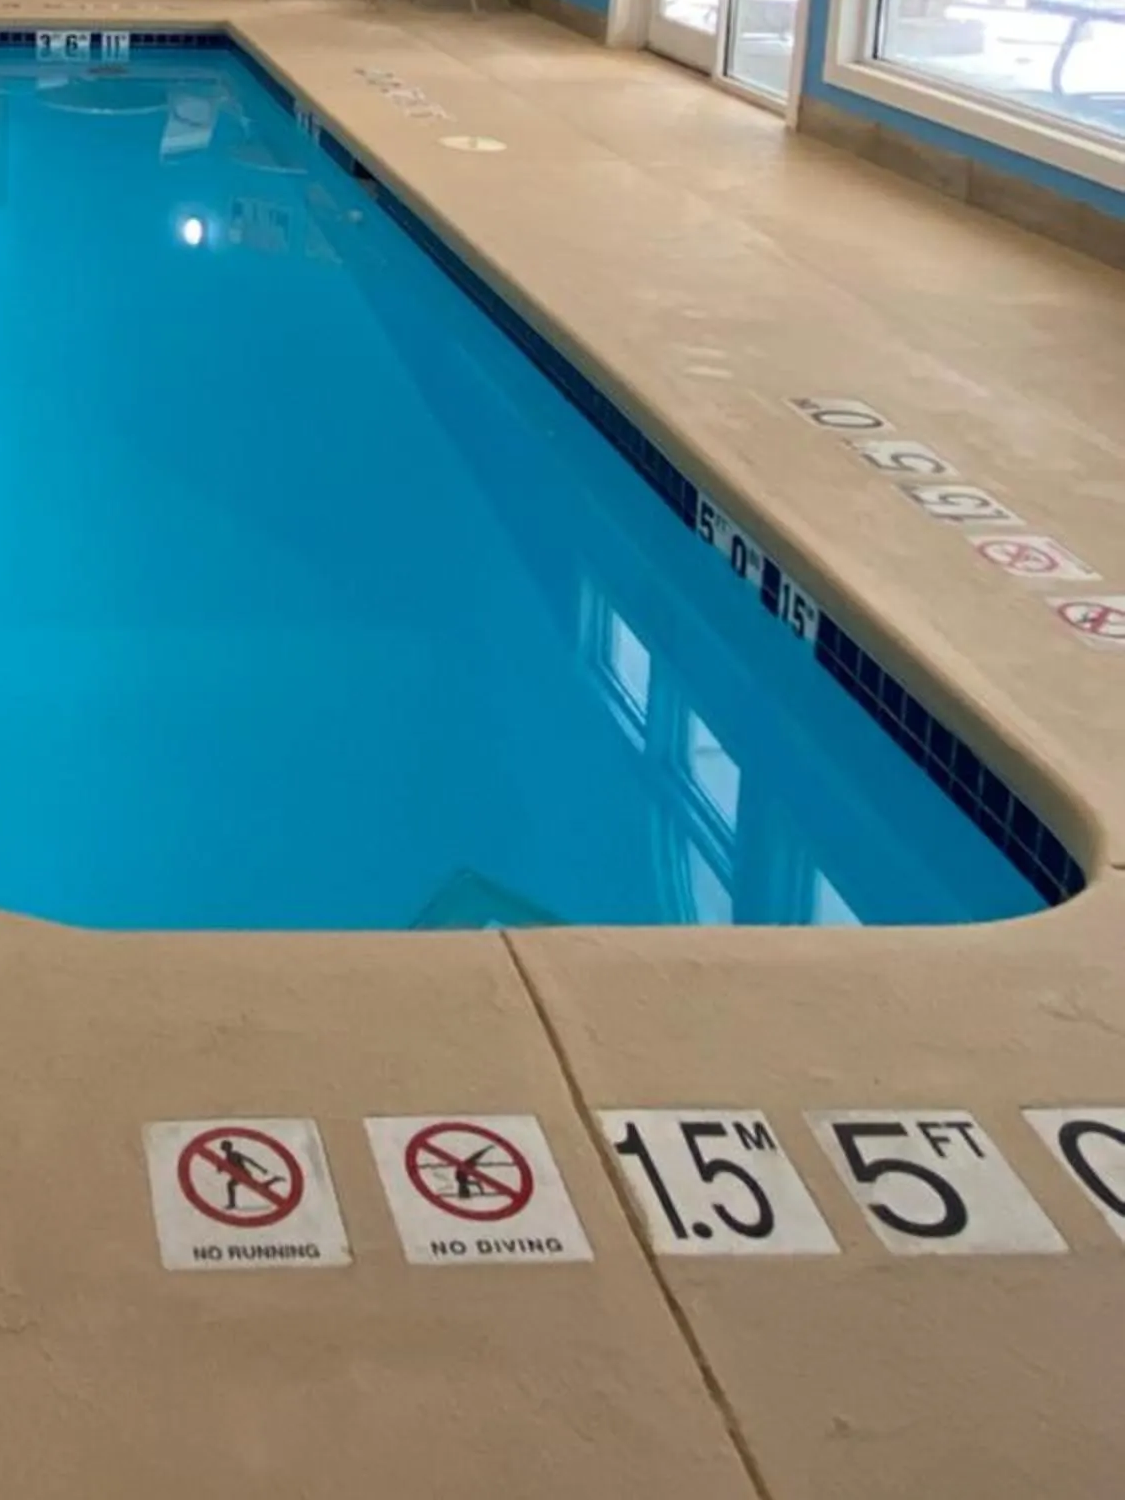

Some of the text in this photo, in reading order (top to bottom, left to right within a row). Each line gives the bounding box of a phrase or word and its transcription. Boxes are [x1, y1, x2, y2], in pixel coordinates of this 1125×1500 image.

[193, 1244, 321, 1261] NO RUNNING
[431, 1237, 564, 1257] NO DIVING
